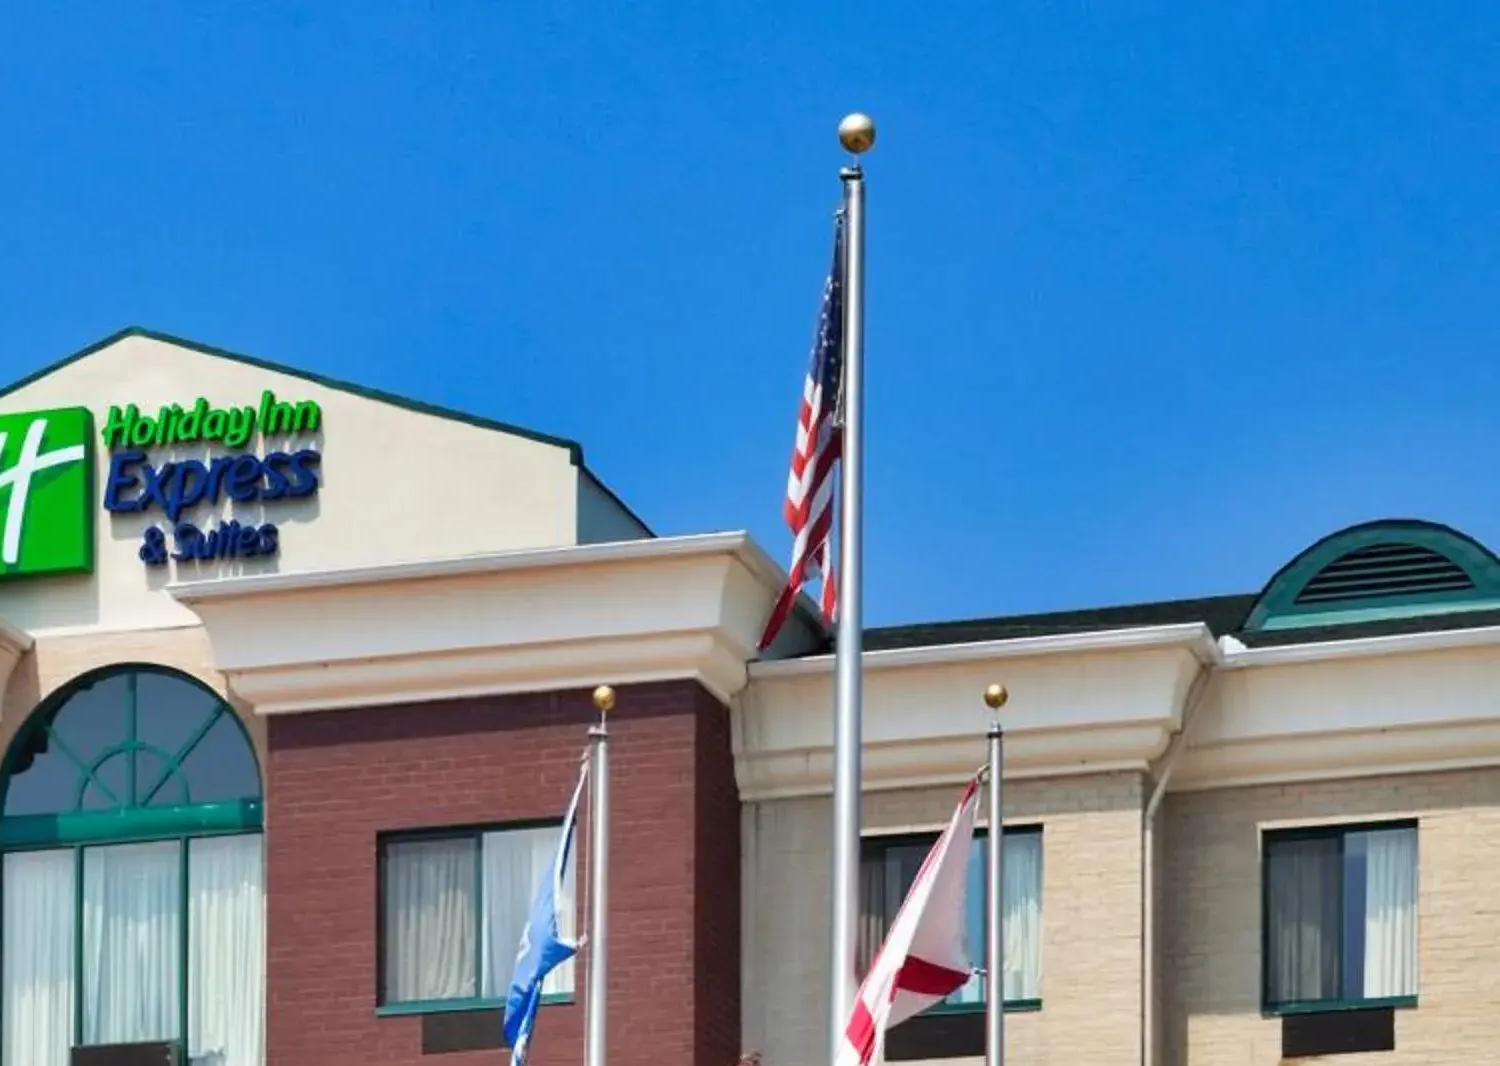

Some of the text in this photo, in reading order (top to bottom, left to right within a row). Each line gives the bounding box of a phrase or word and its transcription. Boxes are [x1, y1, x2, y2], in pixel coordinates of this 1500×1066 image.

[101, 389, 320, 448] Holiday Inn
[104, 449, 321, 524] Express
[139, 518, 279, 565] & Suites
